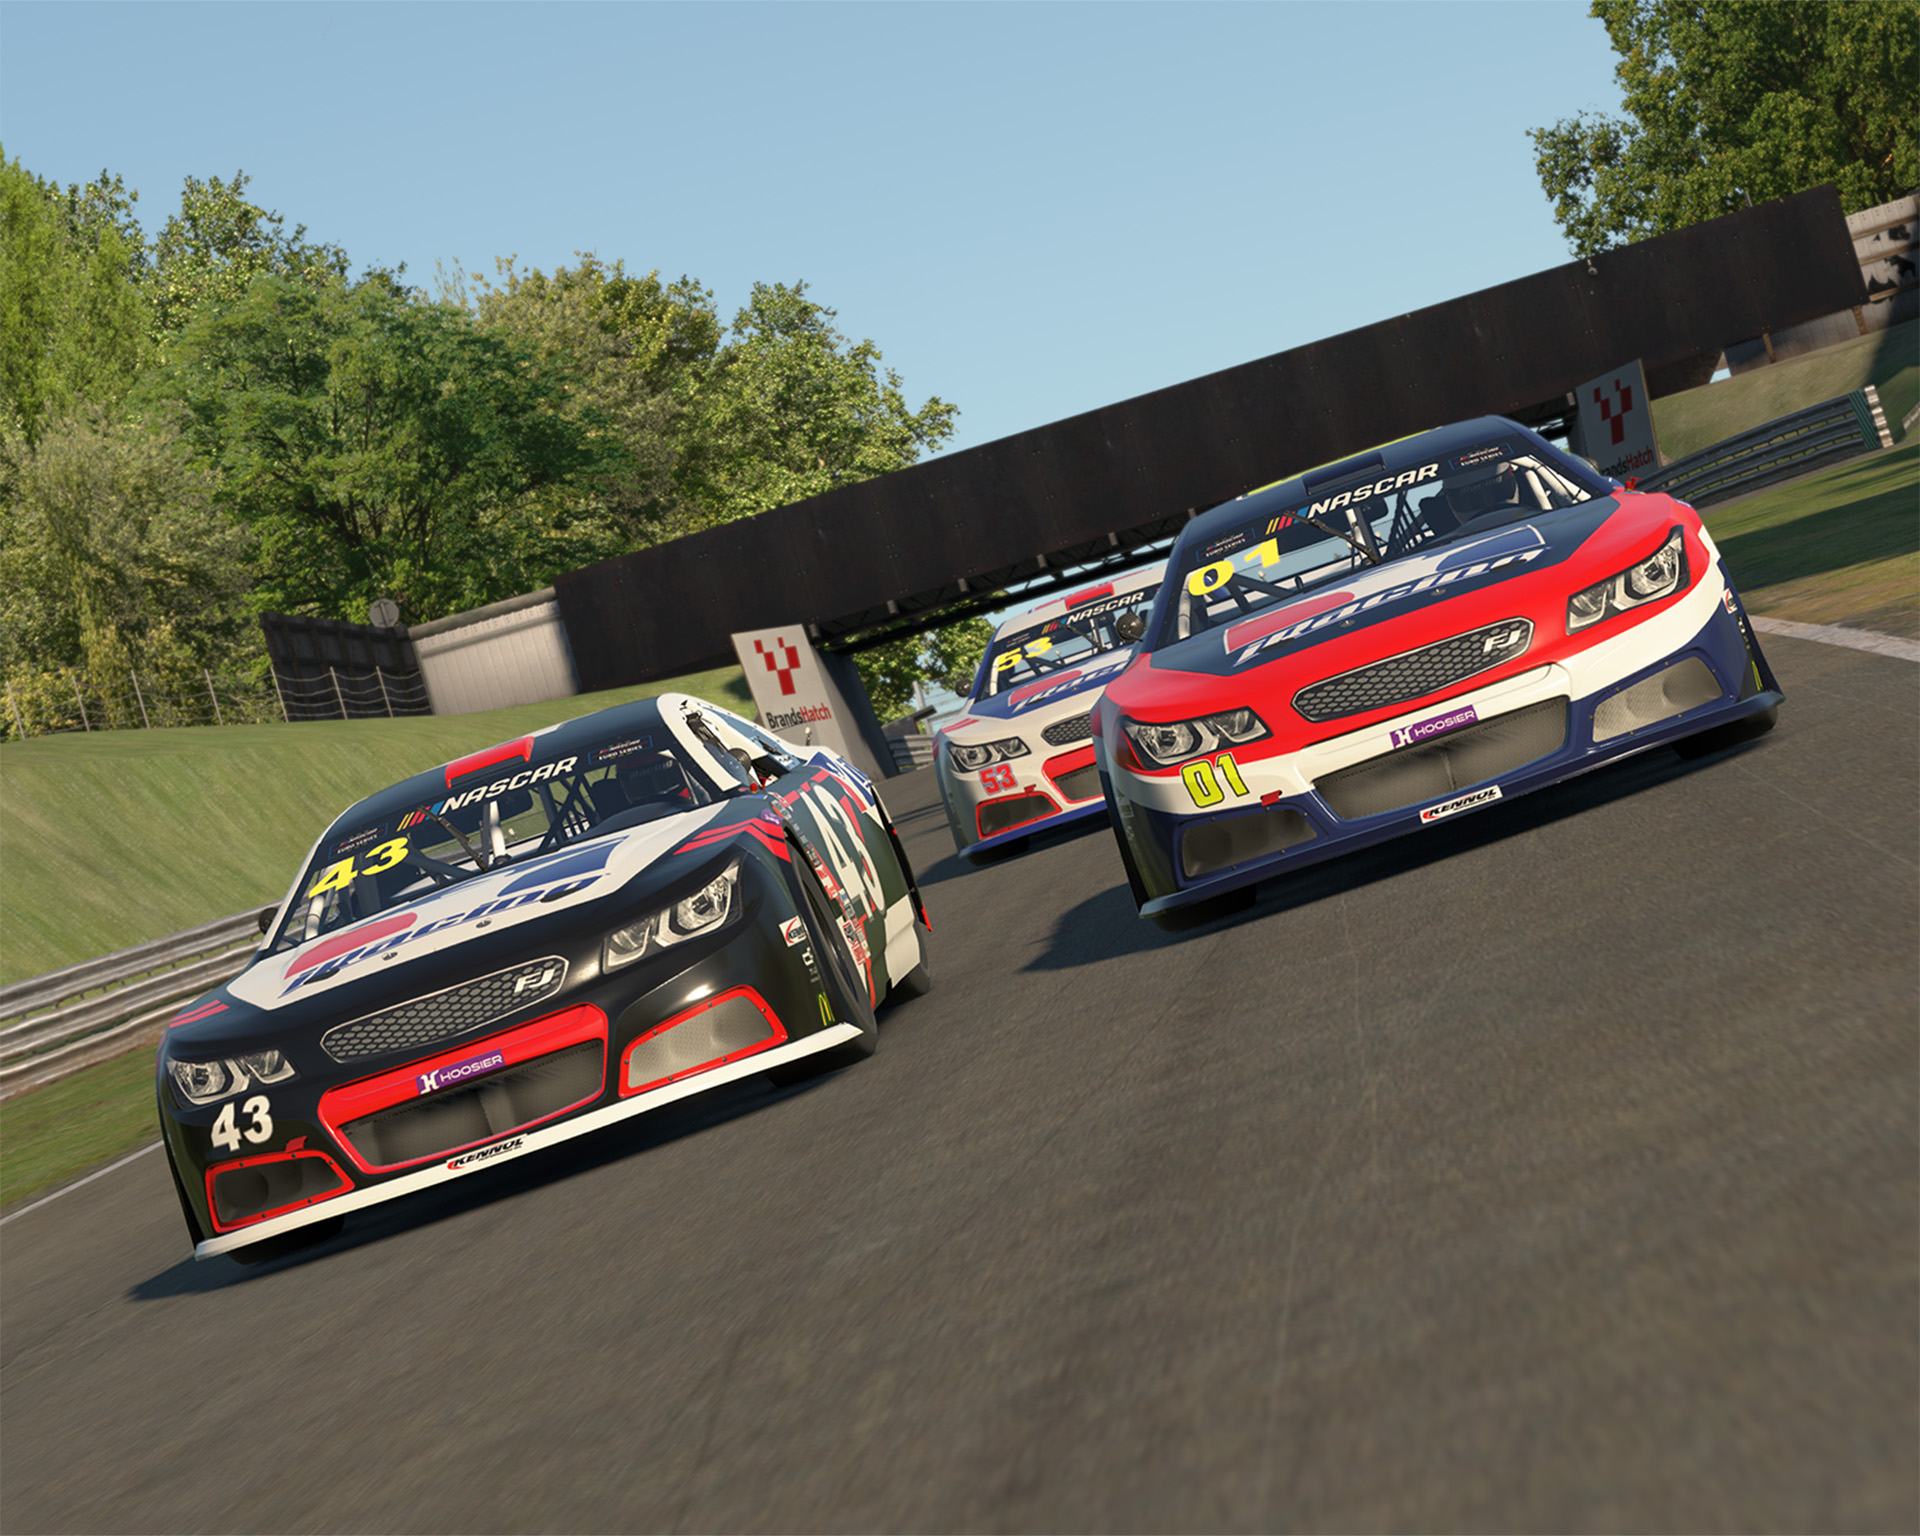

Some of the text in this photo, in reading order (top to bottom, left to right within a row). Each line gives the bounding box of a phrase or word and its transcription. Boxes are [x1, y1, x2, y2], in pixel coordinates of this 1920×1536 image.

[1601, 446, 1655, 478] randsHatch
[1307, 463, 1440, 520] NASCAR
[1188, 537, 1280, 597] 01
[1066, 591, 1145, 626] NASCAR
[996, 637, 1053, 672] 53
[766, 702, 832, 730] BrandsHatch
[1414, 709, 1475, 737] HOOSIER
[438, 756, 578, 816] NASCAR
[978, 762, 1017, 796] 53
[1180, 752, 1250, 809] 01
[1424, 788, 1497, 818] KENNOL
[308, 837, 409, 899] 43
[800, 782, 887, 921] 43
[439, 1053, 503, 1083] HOOSIER
[210, 1094, 273, 1152] 43
[450, 1138, 524, 1168] KENNOL
